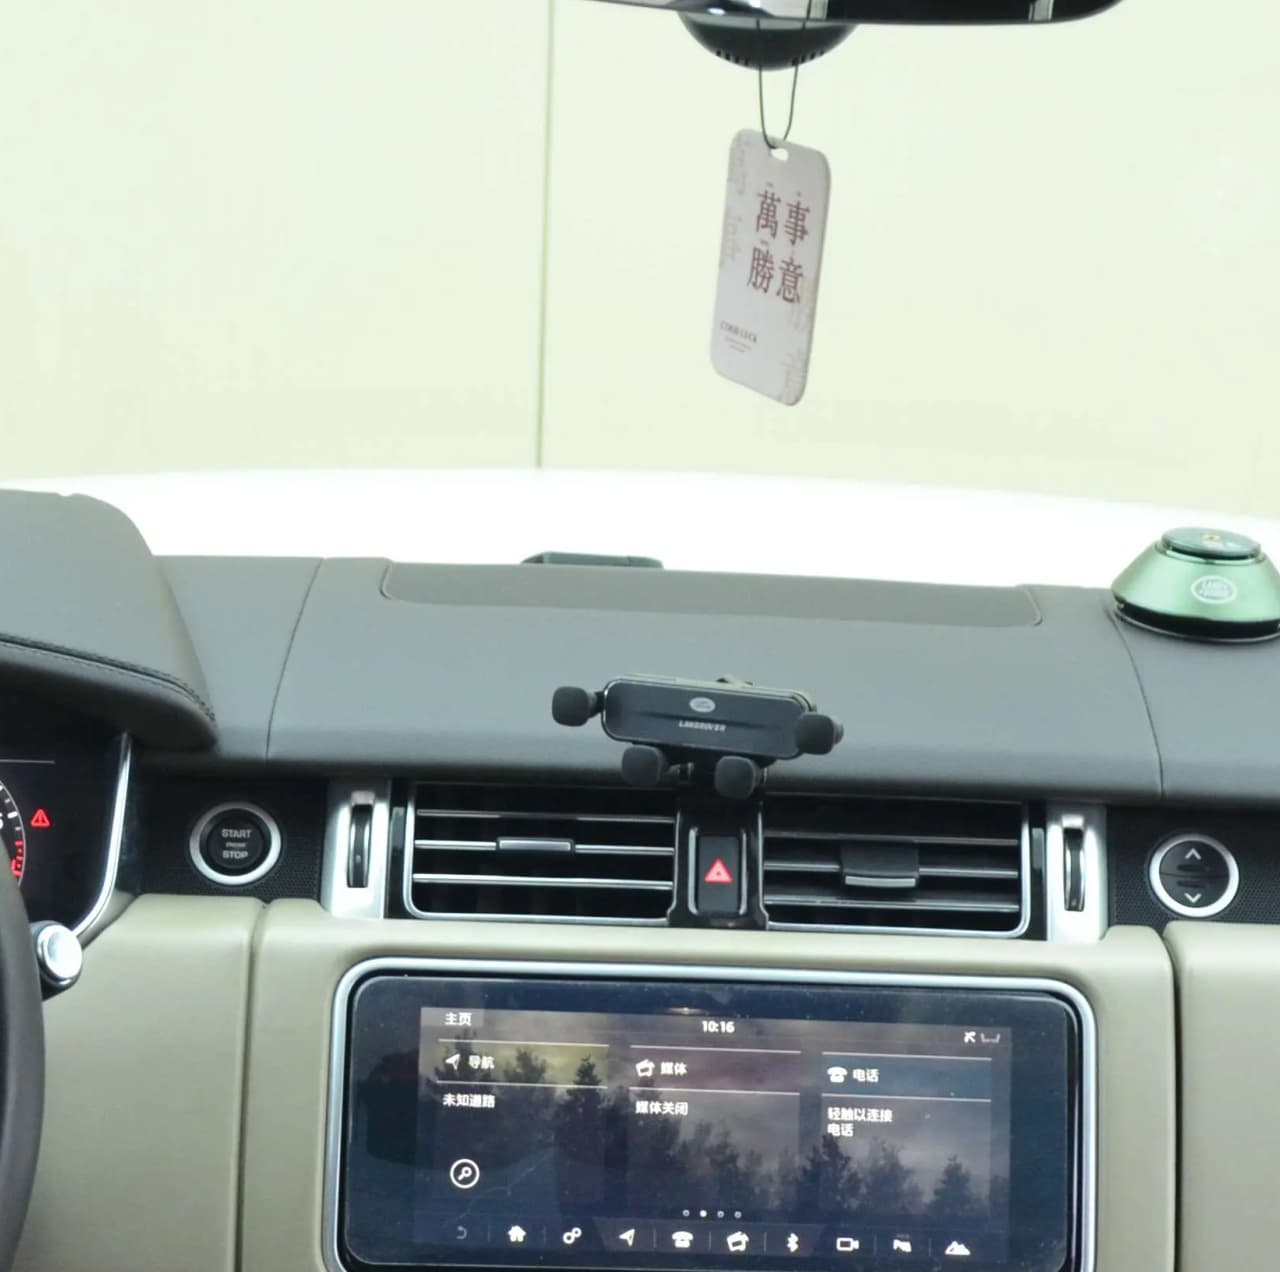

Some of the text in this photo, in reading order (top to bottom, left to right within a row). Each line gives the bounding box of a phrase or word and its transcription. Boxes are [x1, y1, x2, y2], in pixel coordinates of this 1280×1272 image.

[221, 828, 252, 838] START
[222, 850, 248, 859] STOP
[445, 1012, 472, 1026] 主页
[701, 1020, 735, 1033] 10:16
[469, 1055, 495, 1070] 导航
[660, 1062, 687, 1076] 媒体
[852, 1068, 880, 1083] 电话
[443, 1093, 496, 1109] 未知道路
[827, 1123, 854, 1137] 电话
